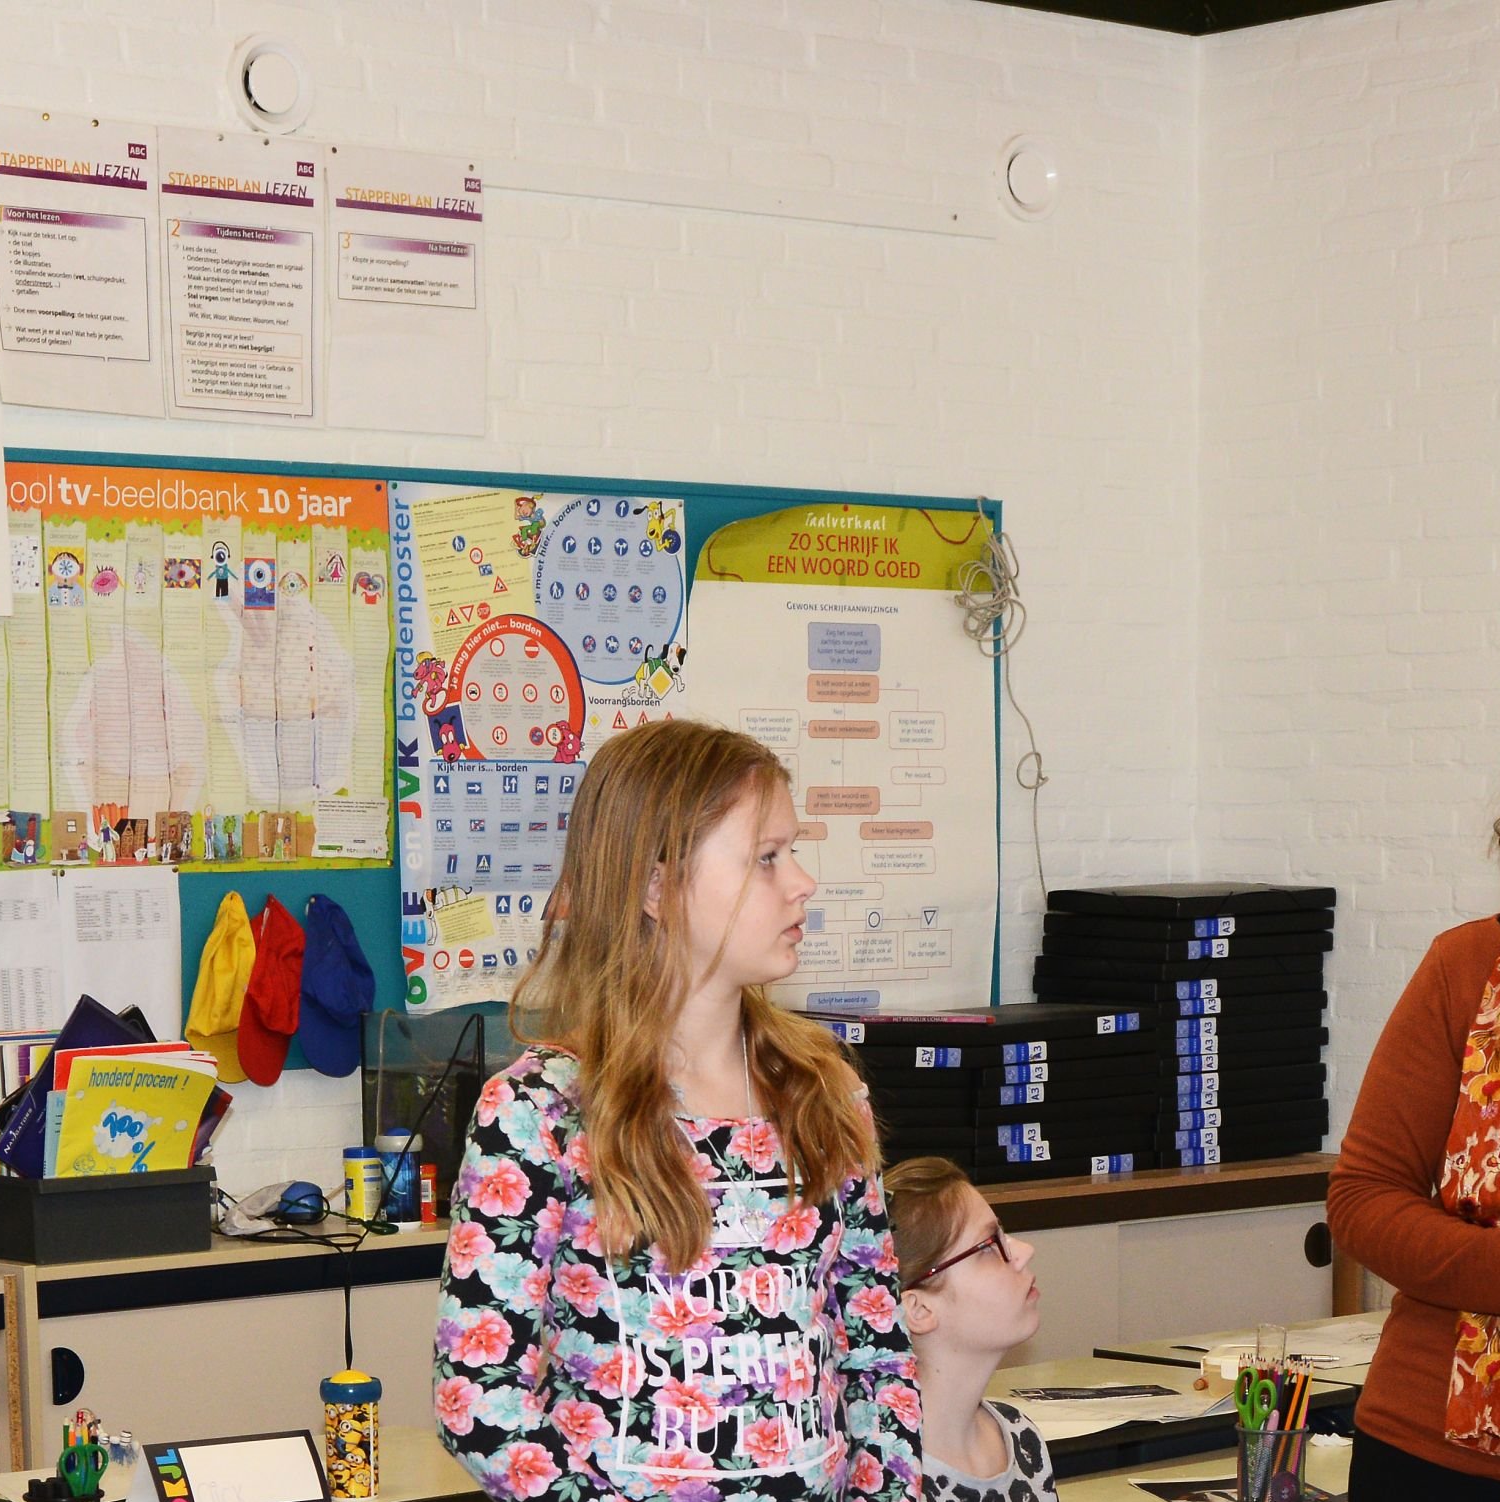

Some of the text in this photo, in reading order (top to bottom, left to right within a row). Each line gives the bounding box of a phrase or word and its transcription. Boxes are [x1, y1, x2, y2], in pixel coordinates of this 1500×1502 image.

[129, 146, 146, 156] ABC
[95, 163, 140, 180] LEZEN
[298, 164, 313, 174] ABC
[168, 172, 307, 198] STAPPENPLAN LEZEN
[465, 181, 480, 190] ABC
[345, 187, 475, 213] STAPPENPLAN LEZEN
[6, 209, 60, 222] Voor het lezen
[171, 219, 274, 240] 2 Tijdens het lezen
[342, 232, 351, 249] 3
[257, 487, 290, 514] 10
[297, 487, 352, 521] jaar
[805, 512, 886, 531] Taalverhaal
[534, 568, 544, 593] moet
[553, 499, 582, 528] borden
[789, 532, 899, 557] ZO SCHRIJF IK
[768, 555, 921, 578] EEN WOORD GOED
[397, 501, 418, 720] bordenposter
[453, 649, 471, 674] mag
[466, 631, 484, 652] hier
[509, 619, 542, 637] borden
[588, 696, 661, 708] Voorrangsborden
[437, 763, 455, 774] Kijk
[457, 763, 474, 772] hier
[495, 763, 528, 772] borden
[398, 737, 422, 819] JVK
[406, 831, 424, 870] en
[851, 1026, 860, 1042] A3
[1204, 1021, 1212, 1034] A3
[1033, 1044, 1042, 1059] A3
[1205, 1039, 1213, 1051] A3
[1206, 1056, 1214, 1068] A3
[88, 1067, 178, 1092] honderd procent
[1035, 1065, 1044, 1080] A3
[1207, 1077, 1214, 1090] A3
[1030, 1086, 1039, 1101] A3
[1205, 1093, 1213, 1105] A3
[1209, 1113, 1217, 1125] A3
[1028, 1128, 1036, 1142] A3
[1205, 1132, 1213, 1144] A3
[1036, 1145, 1045, 1159] A3
[1208, 1149, 1216, 1161] A3
[1096, 1157, 1105, 1172] A3
[633, 1332, 823, 1387] IS PERFEC
[655, 1405, 756, 1456] BUT
